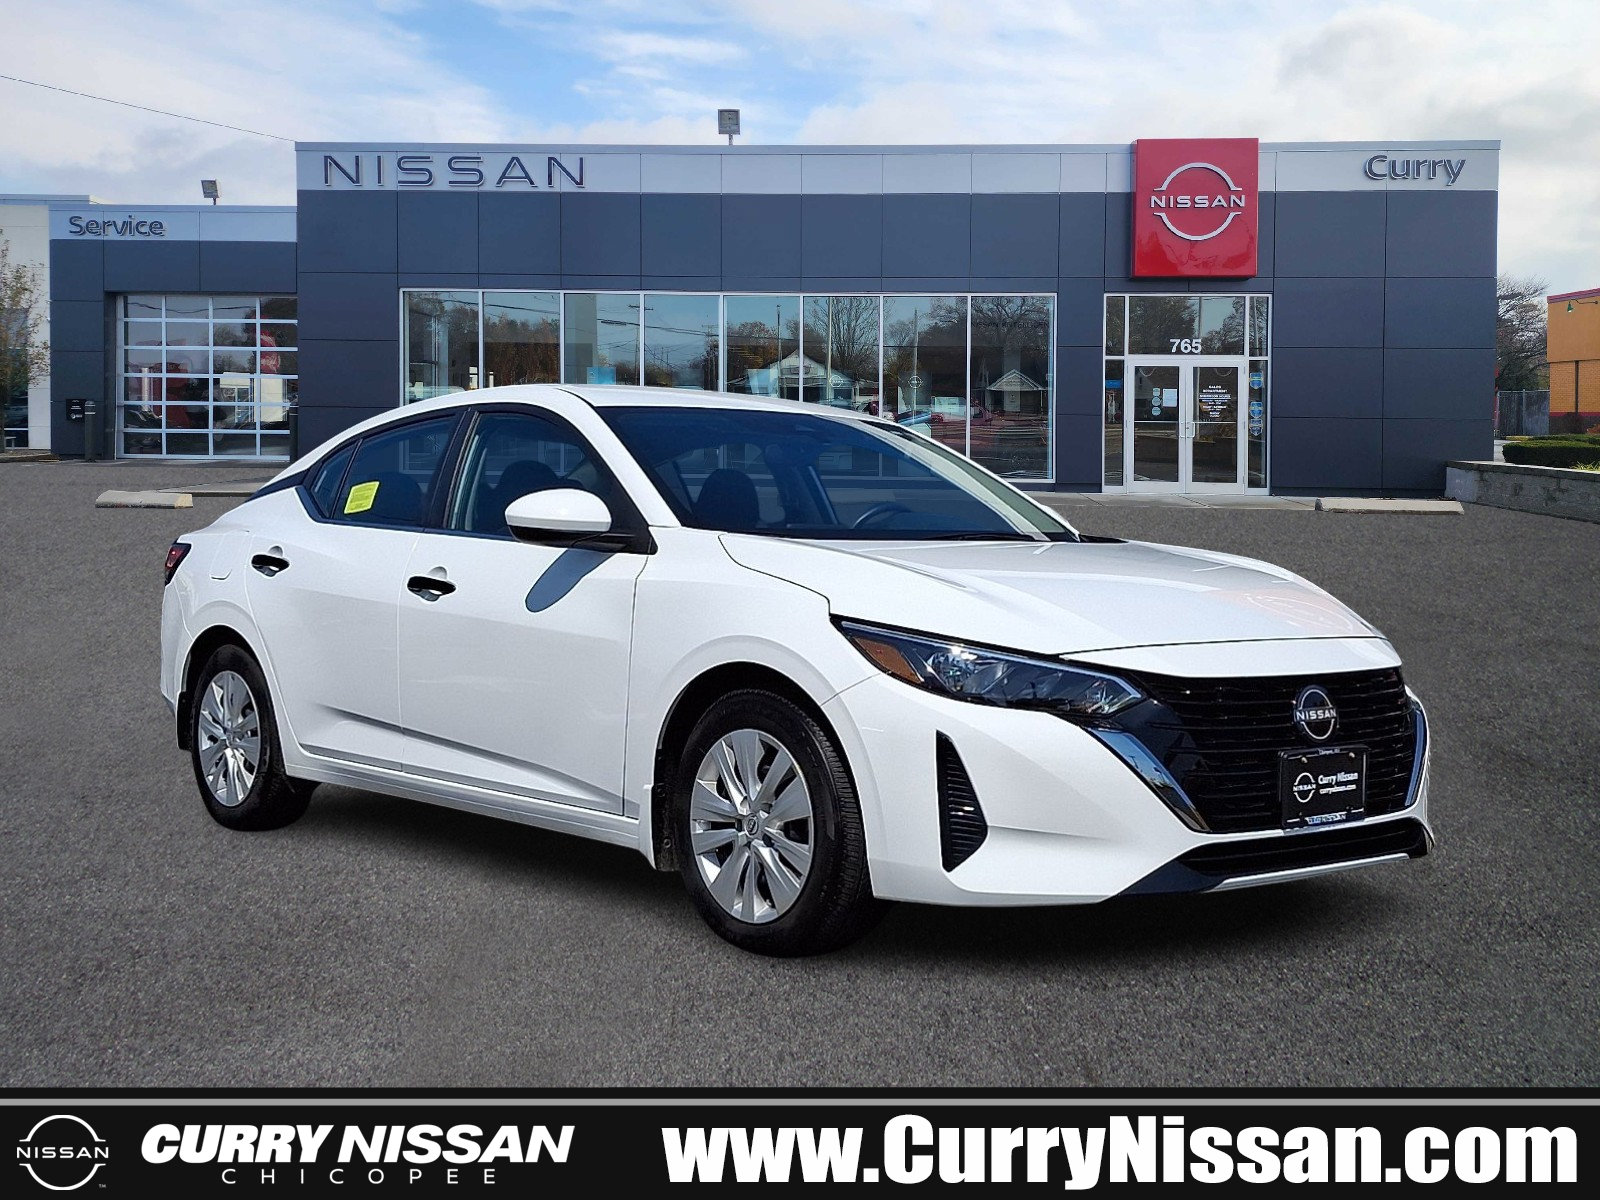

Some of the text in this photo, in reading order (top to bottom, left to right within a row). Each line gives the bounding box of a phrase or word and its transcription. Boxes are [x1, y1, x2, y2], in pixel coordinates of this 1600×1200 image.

[323, 154, 587, 188] NISSAN
[1364, 154, 1467, 187] Curry
[1150, 193, 1246, 208] NISSAN
[68, 213, 166, 238] Service
[1170, 338, 1202, 353] 765
[1296, 708, 1336, 720] NISSAN
[1318, 772, 1358, 785] Curry Nissan
